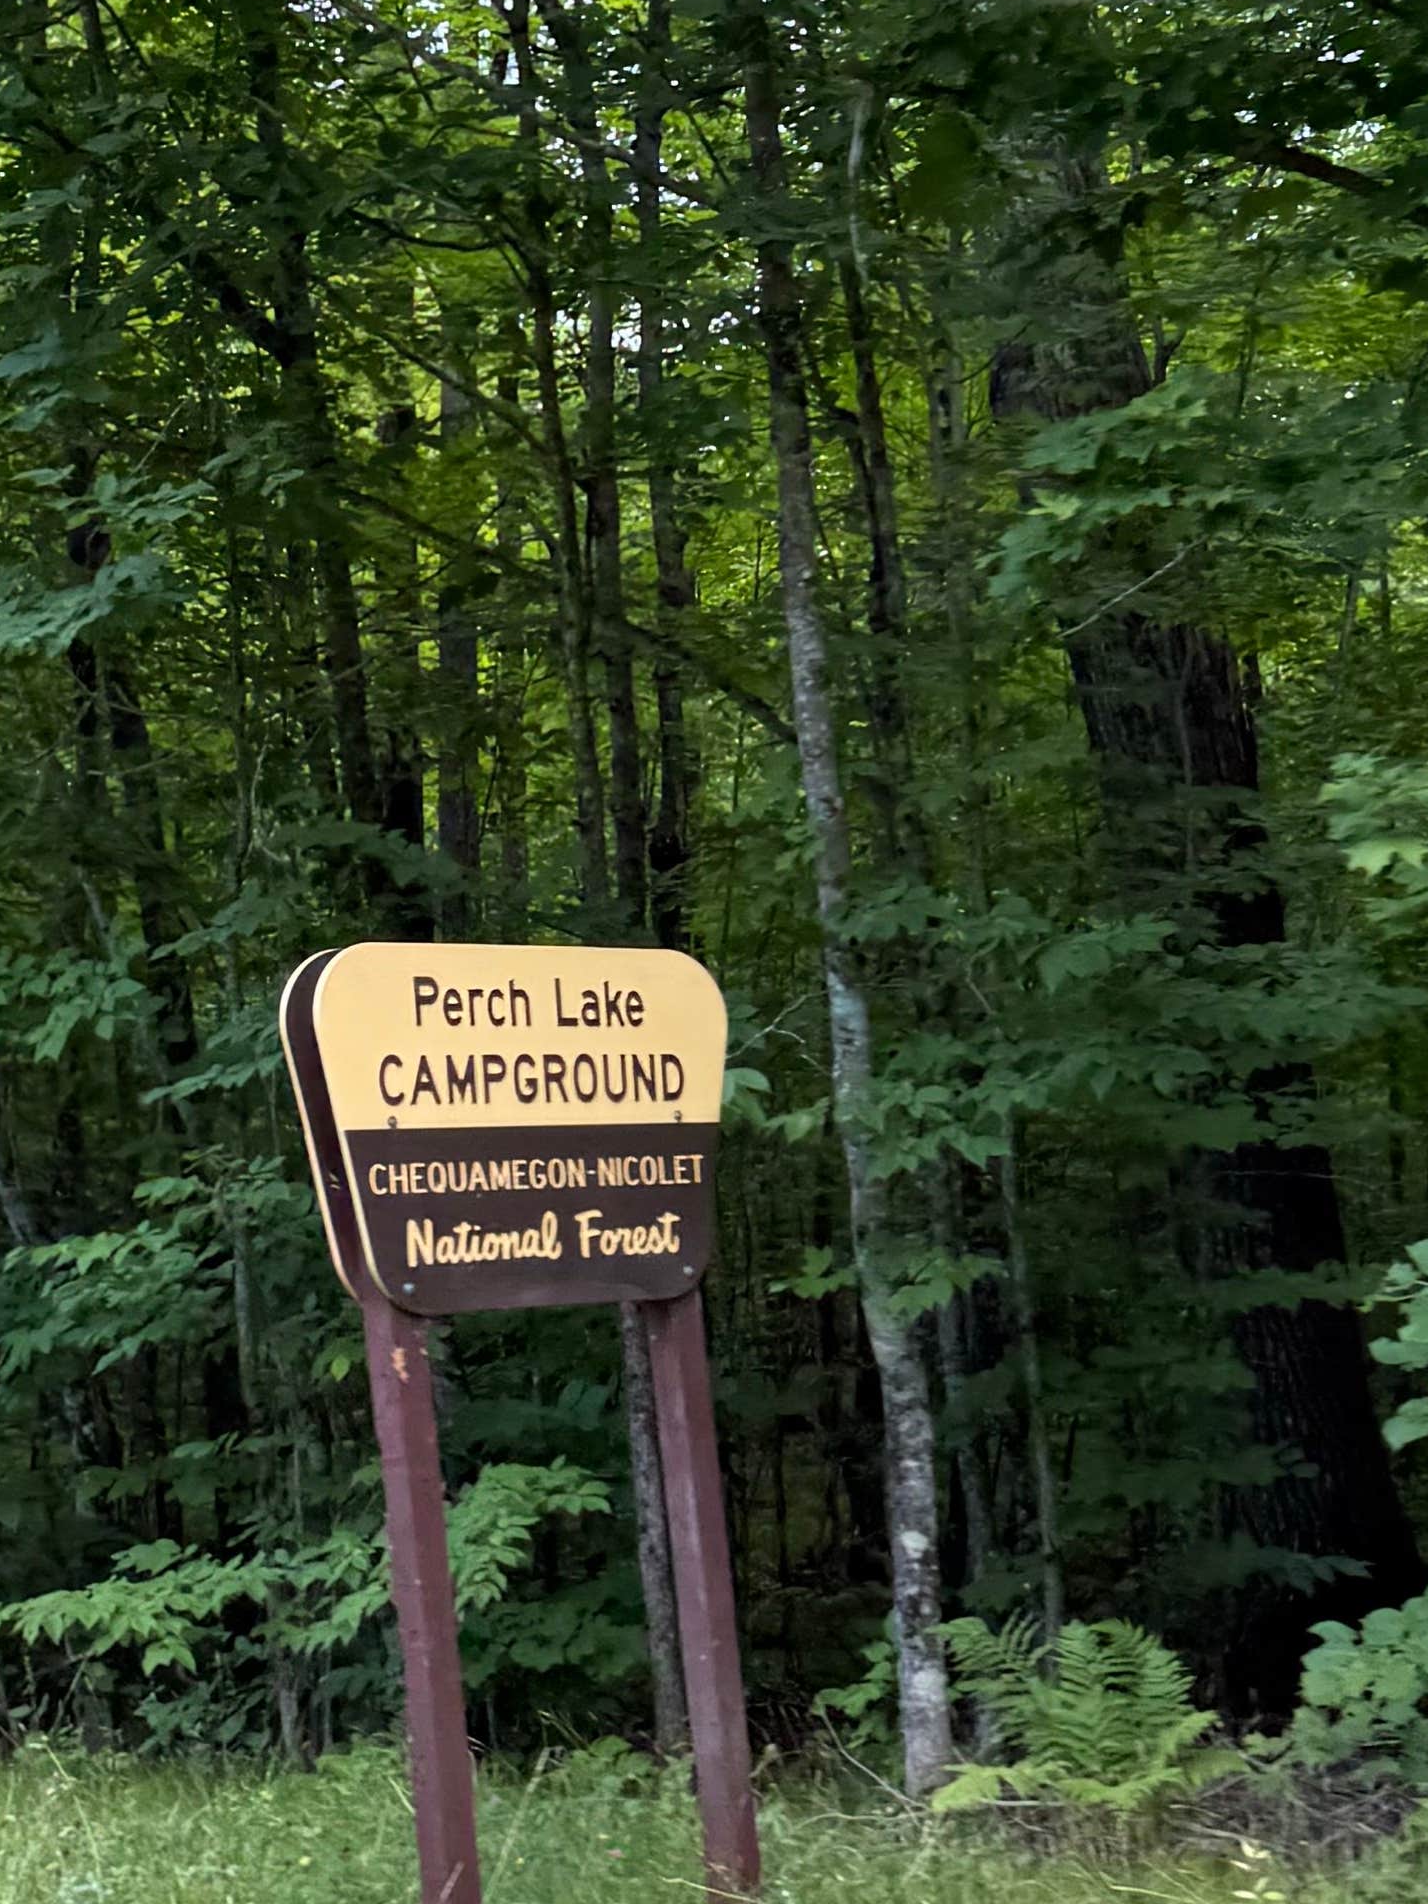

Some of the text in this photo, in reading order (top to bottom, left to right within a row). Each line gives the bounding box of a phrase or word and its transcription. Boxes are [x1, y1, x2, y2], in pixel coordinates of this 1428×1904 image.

[413, 976, 644, 1027] Perch Lake
[379, 1053, 684, 1106] CAMPGROUND
[368, 1154, 704, 1195] CHEQUAMEGON-NICOLET
[406, 1209, 681, 1268] National Forest
